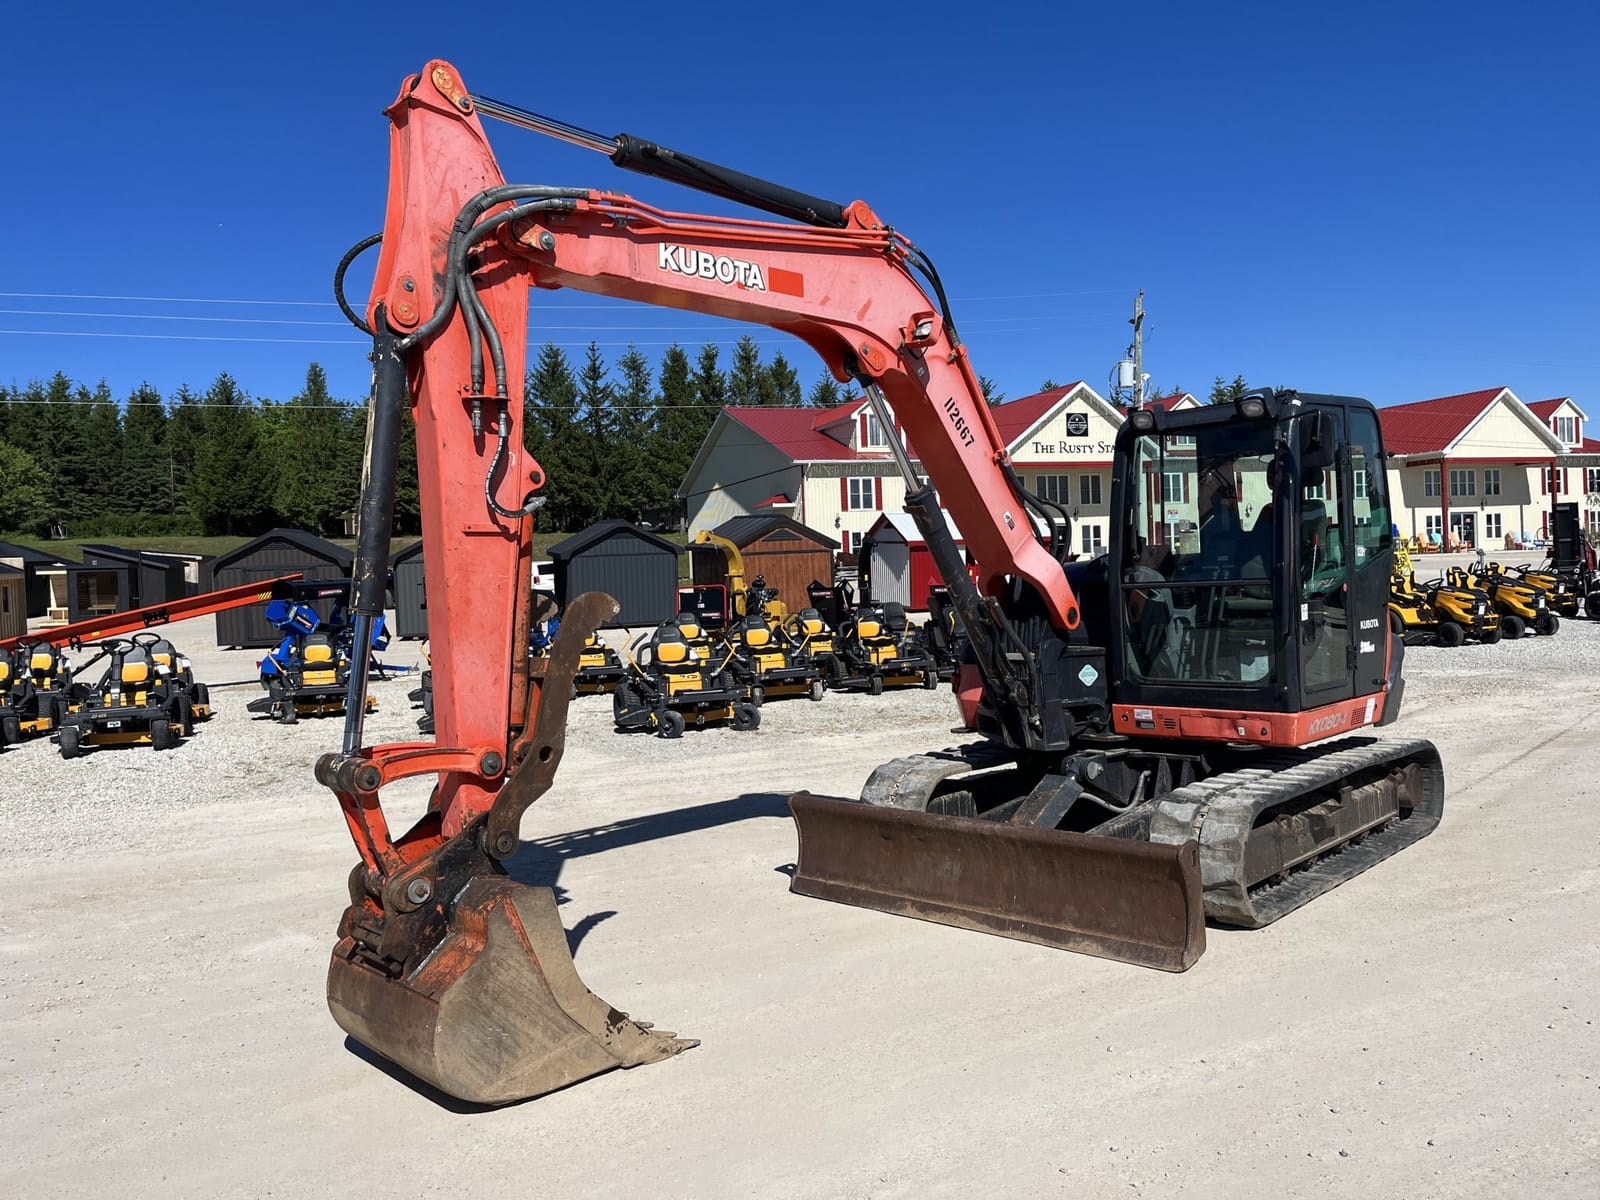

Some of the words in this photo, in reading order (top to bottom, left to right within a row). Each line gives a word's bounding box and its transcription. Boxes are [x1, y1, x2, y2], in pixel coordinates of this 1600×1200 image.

[658, 242, 766, 291] KUBOTA
[944, 396, 975, 448] 112667
[1032, 441, 1055, 454] THE
[1059, 440, 1095, 454] RUSTY
[1360, 618, 1379, 630] KUBOTA
